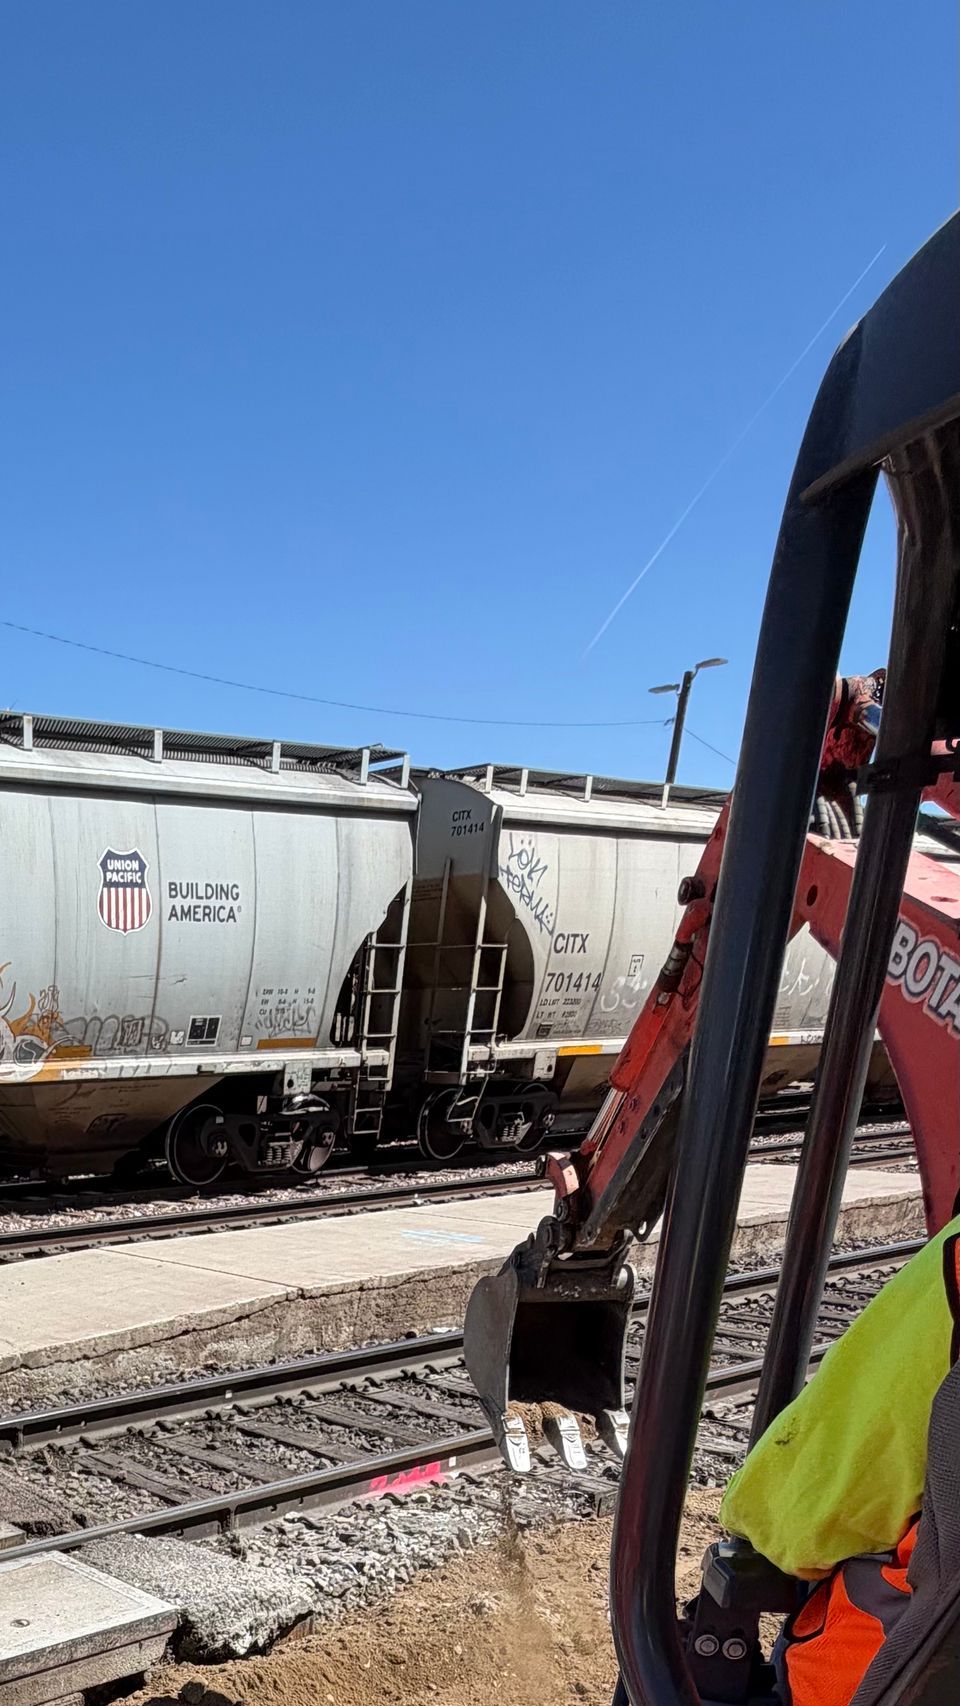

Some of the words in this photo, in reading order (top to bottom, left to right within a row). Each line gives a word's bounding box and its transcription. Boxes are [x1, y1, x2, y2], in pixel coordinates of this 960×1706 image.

[452, 809, 472, 822] CITX
[451, 822, 484, 837] 701414
[107, 859, 139, 871] UNION
[106, 871, 142, 883] PACIFIC
[168, 881, 240, 901] BUILDING
[553, 933, 589, 954] CITX
[545, 972, 602, 993] 701414
